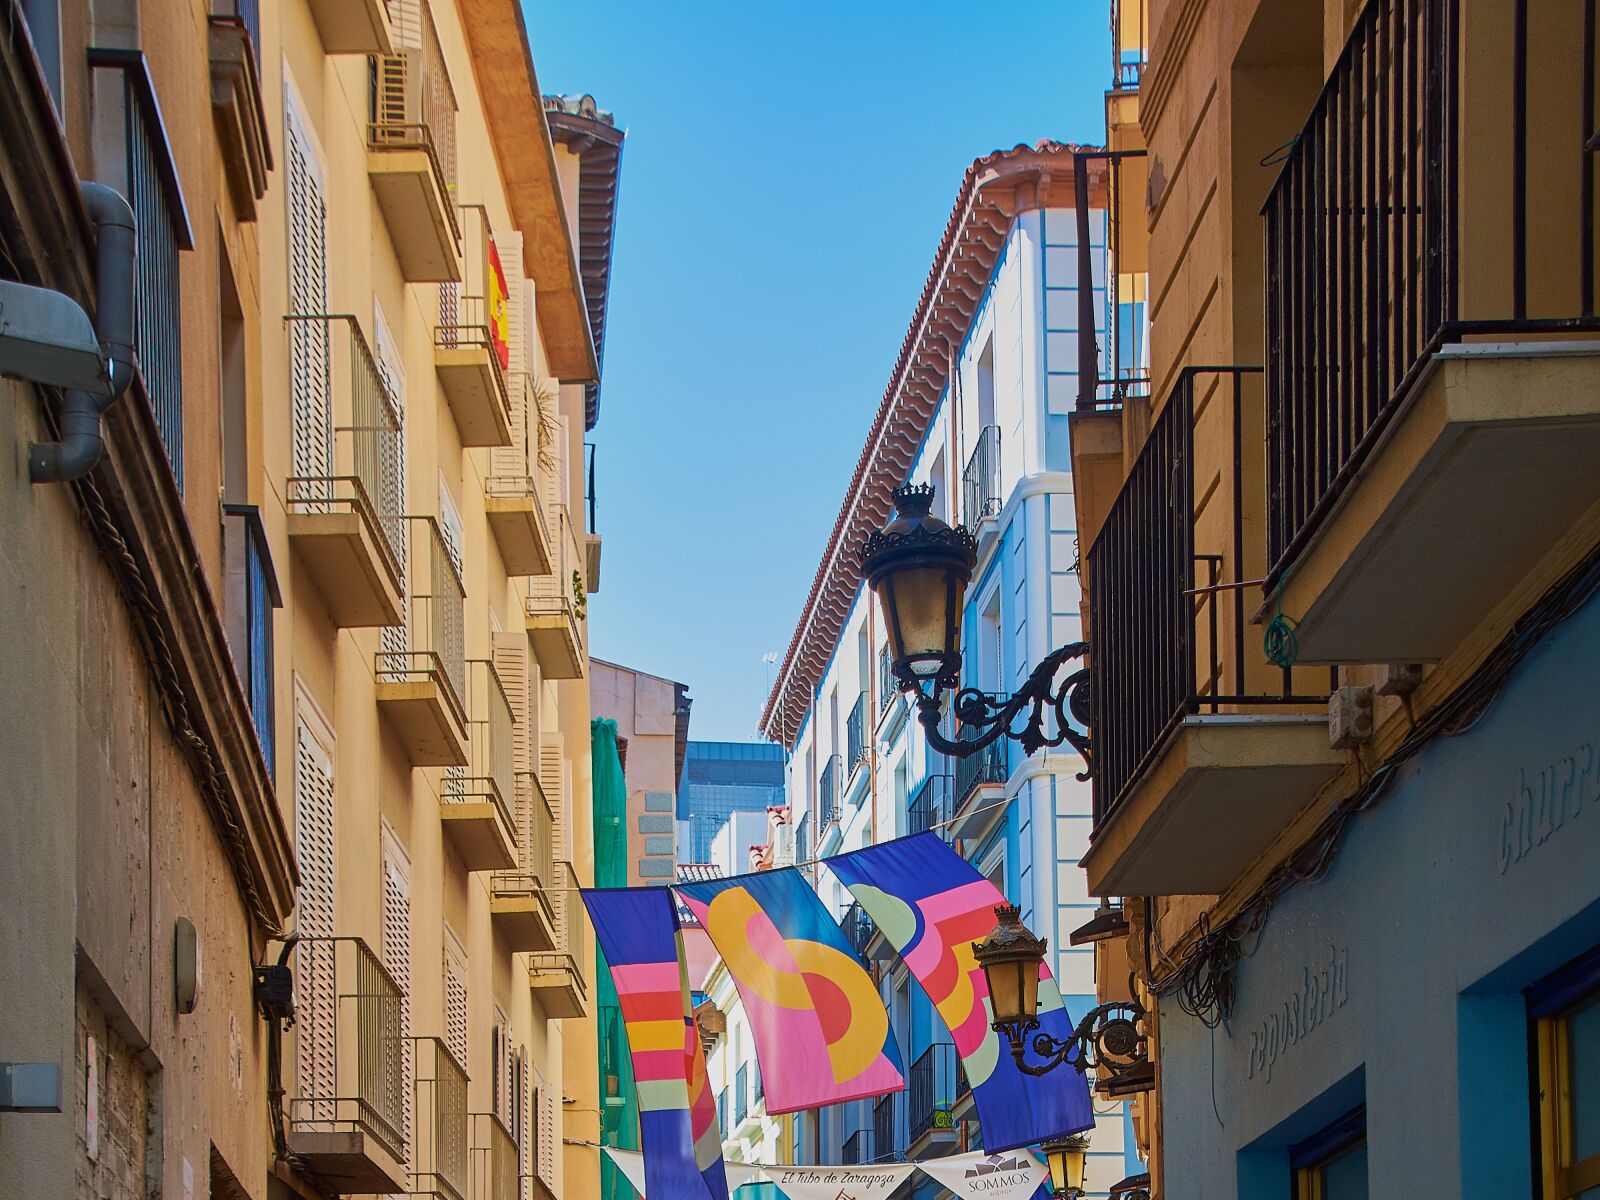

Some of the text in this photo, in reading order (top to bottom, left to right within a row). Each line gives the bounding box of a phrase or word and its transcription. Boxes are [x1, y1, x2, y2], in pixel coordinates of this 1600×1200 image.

[781, 1171, 895, 1189] El Tubo de Zaragoza
[968, 1171, 1029, 1193] SOMMOS
